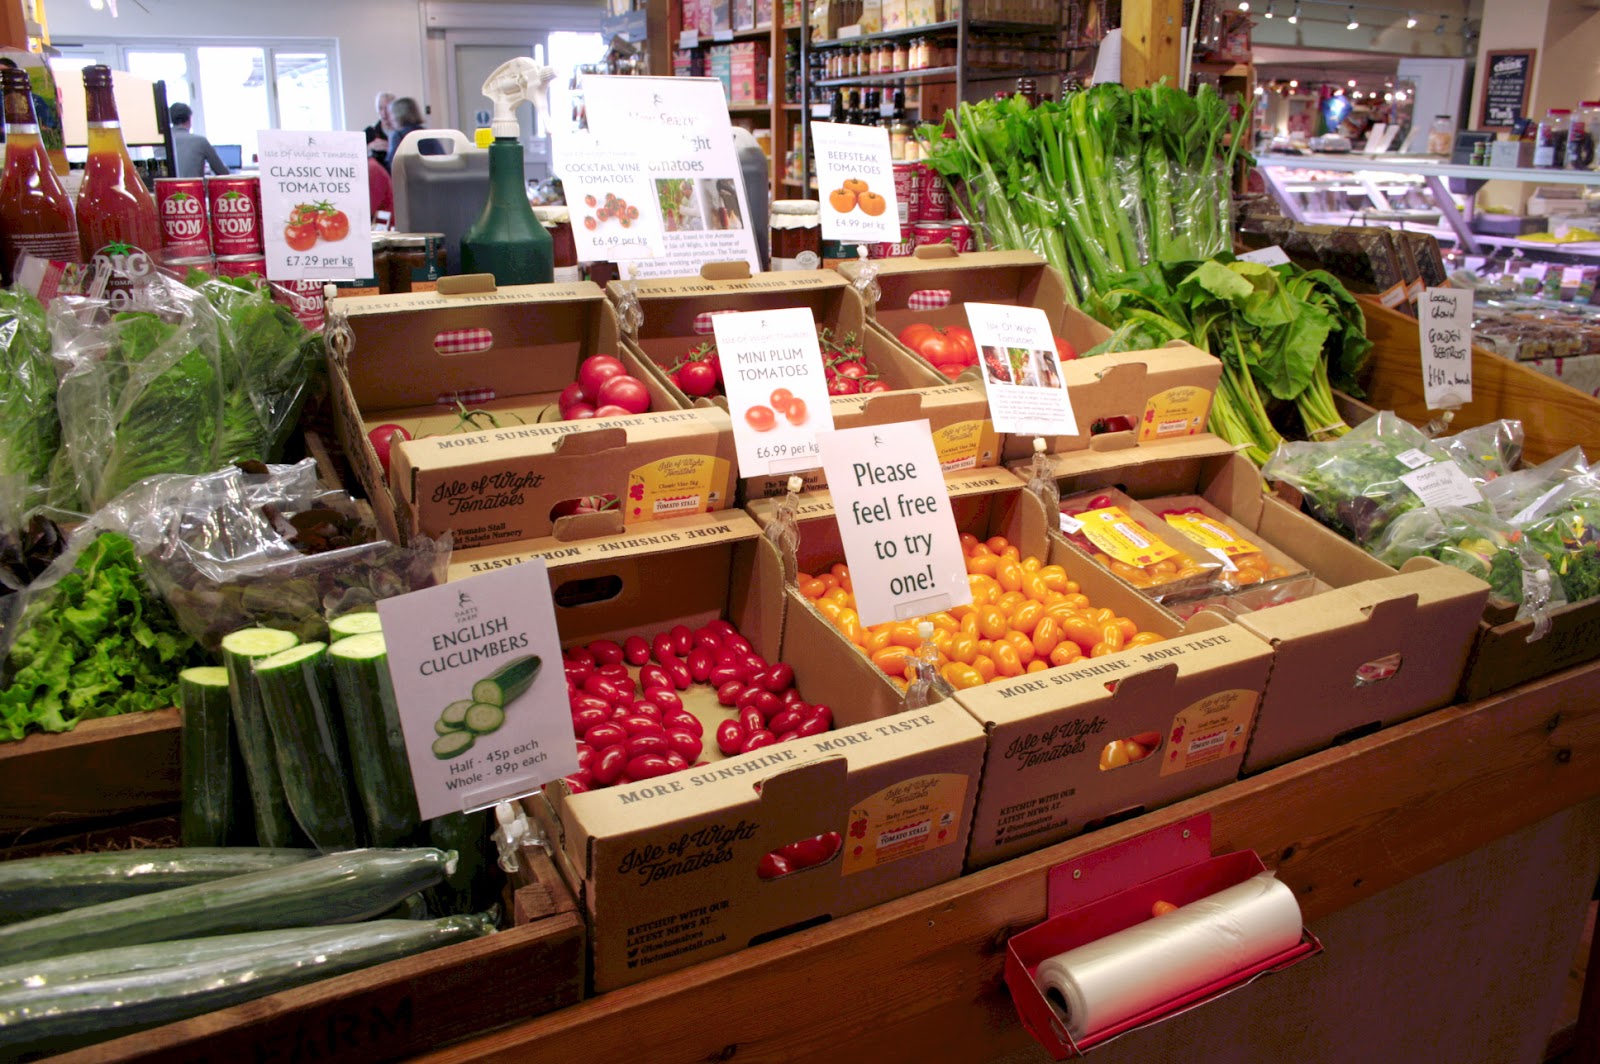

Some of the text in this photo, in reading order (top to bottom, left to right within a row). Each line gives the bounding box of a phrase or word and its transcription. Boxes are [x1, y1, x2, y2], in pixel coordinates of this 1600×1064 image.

[828, 151, 878, 163] BEEFSTEAK
[270, 166, 356, 178] CLASSIC VINE
[565, 163, 640, 172] COCKTAIL VINE
[828, 162, 881, 175] TOMATOES
[579, 174, 634, 184] TOMATOES
[278, 182, 351, 193] TOMATOES
[217, 197, 251, 213] BIG
[931, 191, 946, 204] TO
[165, 199, 199, 215] BIG
[166, 220, 200, 235] TOM
[218, 218, 252, 233] TOM
[836, 219, 886, 230] £4.99 per kg
[593, 236, 647, 246] £6.49 per kg
[286, 256, 353, 267] £7.29 per kg
[679, 284, 715, 293] MORE
[726, 279, 786, 290] SUNSHINE
[789, 278, 823, 287] MORE
[407, 297, 448, 307] MORE
[538, 290, 577, 298] MORE
[356, 302, 399, 311] TASTE
[737, 347, 803, 364] MINI PLUM
[738, 364, 809, 381] TOMATOES
[932, 385, 974, 395] TASTE
[438, 412, 698, 449] MORE SUNSHINE MORE TASTE
[756, 442, 820, 459] £6.99 per kg
[853, 461, 918, 487] Please
[432, 471, 545, 502] Isle of Wight
[962, 478, 999, 489] MORE
[447, 492, 525, 516] Tomatoes
[656, 499, 698, 510] TOMATO STALL
[851, 493, 938, 526] feel free
[457, 522, 506, 536] Tomato Stall
[464, 533, 491, 543] Salads
[492, 529, 523, 539] Nursery
[684, 524, 732, 539] MORE
[597, 532, 681, 552] SUNSHINE
[874, 533, 932, 560] to try
[469, 557, 521, 573] TASTE
[890, 564, 936, 596] one!
[454, 606, 479, 618] DARTS
[457, 613, 478, 624] FARM
[432, 616, 509, 651] ENGLISH
[419, 632, 529, 676] CUCUMBERS
[997, 634, 1232, 699] MORE SUNSHINE MORE TASTE
[1004, 715, 1108, 759] Isle of Wight
[449, 758, 474, 775] Half
[486, 749, 510, 763] 45p
[513, 739, 539, 755] each
[618, 714, 936, 805] MORE SUNSHINE MORE TASTE
[1017, 741, 1087, 772] Tomatoes
[445, 773, 483, 791] Whole
[494, 762, 519, 776] 89p
[522, 751, 548, 767] each
[999, 787, 1076, 816] KETCHUP WITH OUR
[997, 806, 1050, 827] LATEST NEWS
[880, 825, 928, 845] TOMATO STALL
[617, 820, 760, 874] Isle of Wight
[638, 847, 734, 887] Tomatoes
[627, 900, 729, 936] KETCHUP WITH OUR
[626, 921, 696, 948] LATEST NEWS
